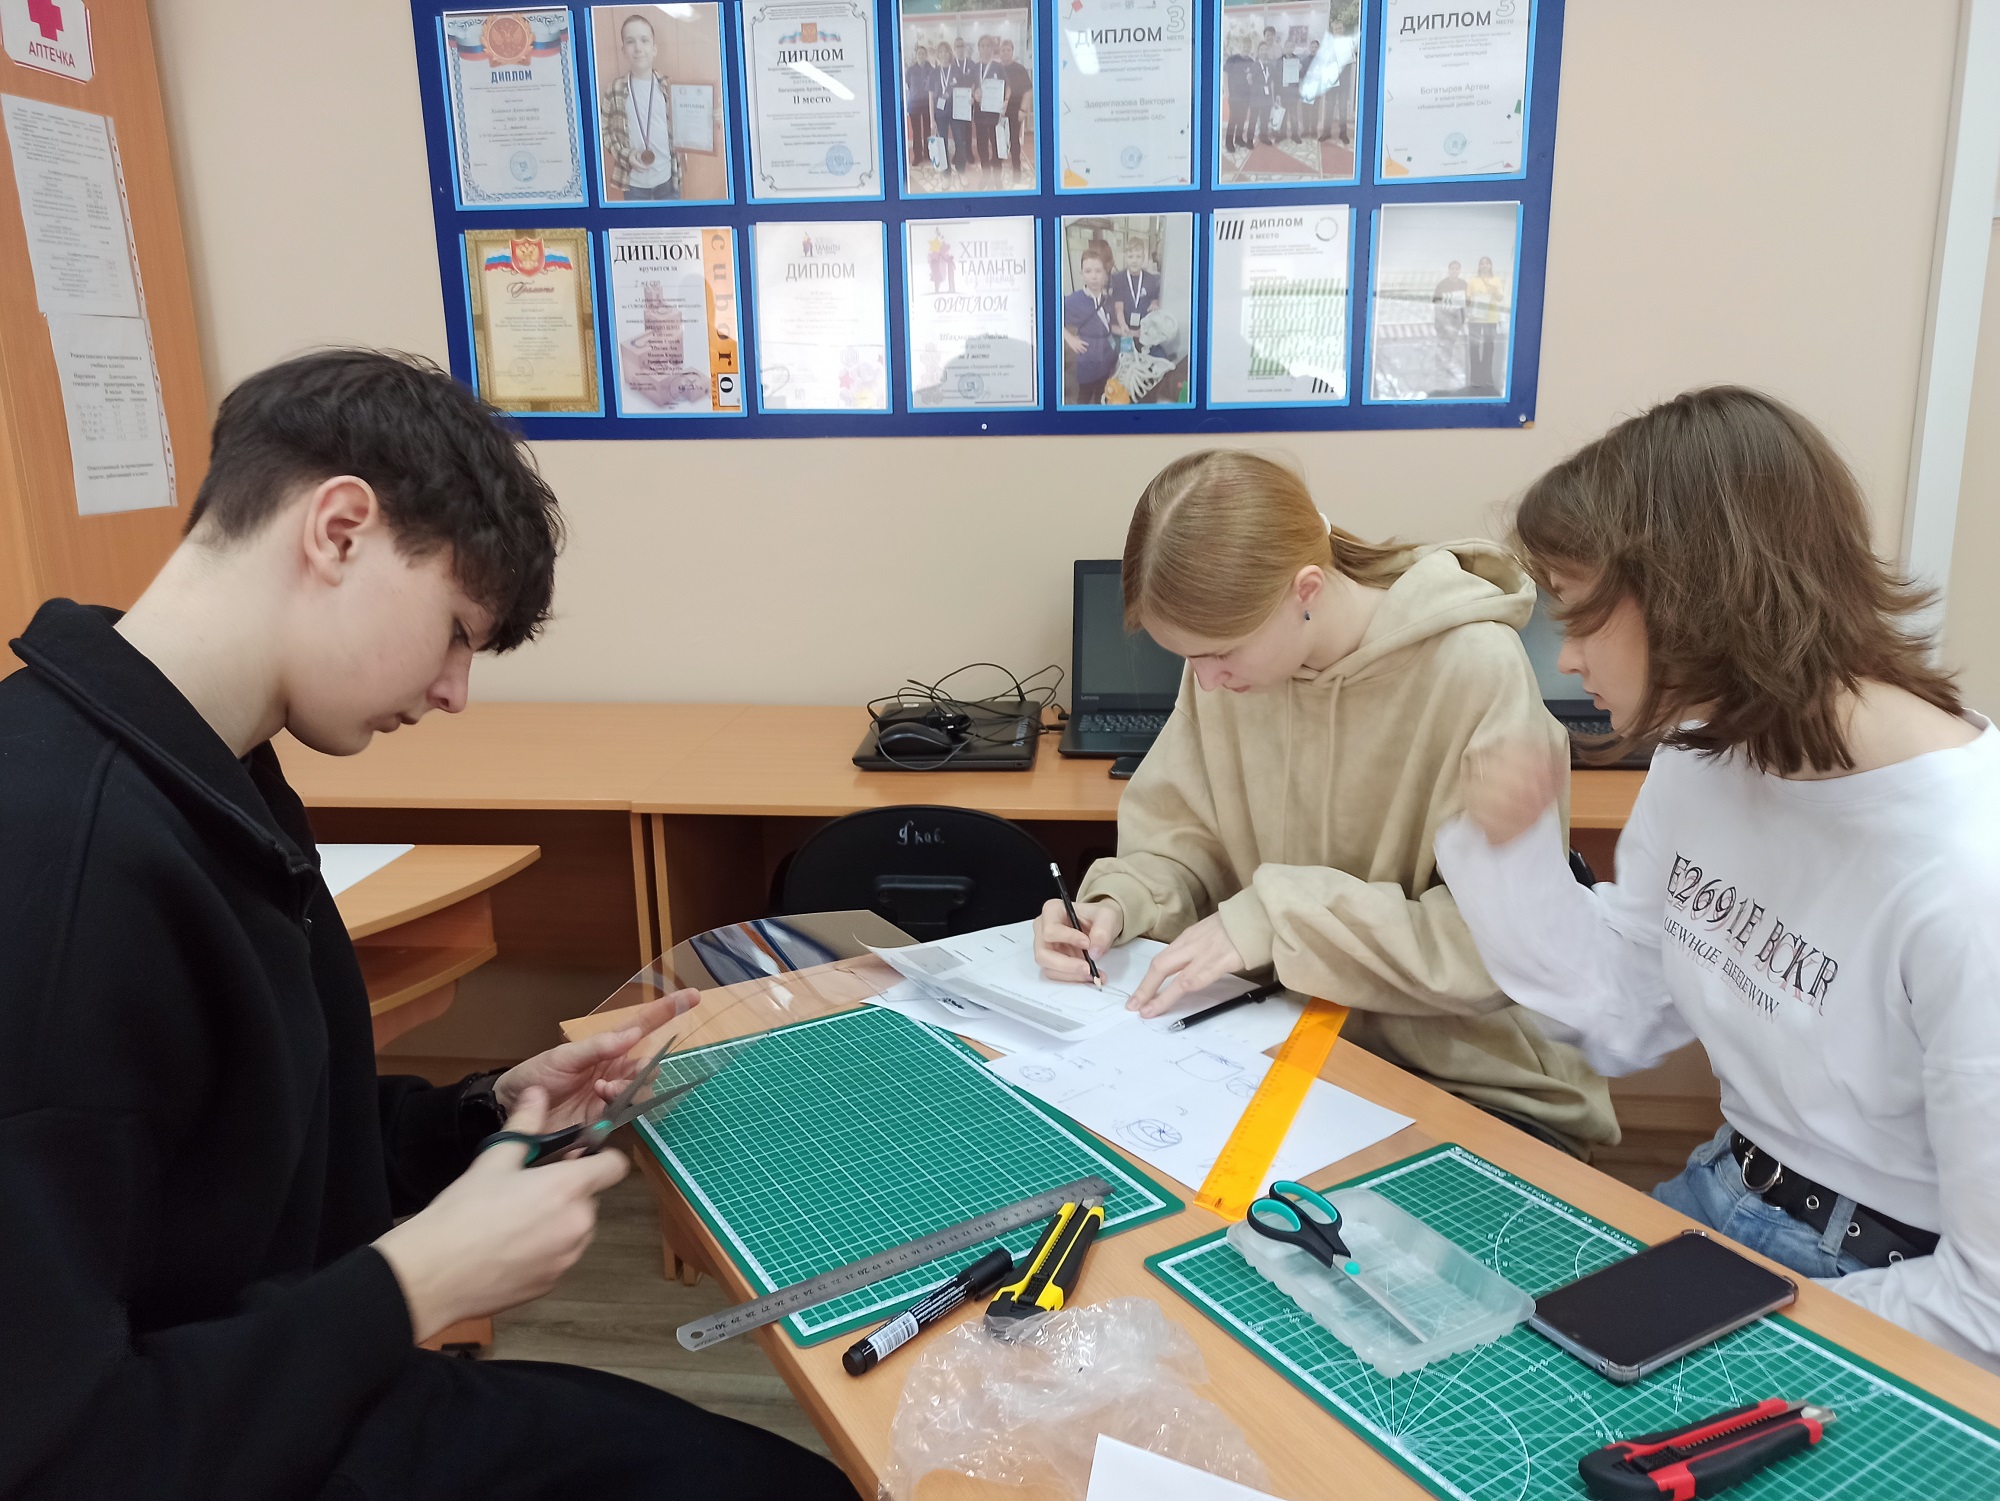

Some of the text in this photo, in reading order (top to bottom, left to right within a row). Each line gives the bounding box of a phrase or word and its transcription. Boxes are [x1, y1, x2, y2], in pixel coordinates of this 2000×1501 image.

[1166, 5, 1185, 33] 3
[1400, 11, 1491, 35] ДИПЛОМ
[1075, 26, 1162, 48] ДИПЛОМ
[29, 41, 76, 69] АПТЕЧКА
[777, 48, 844, 66] ДИПЛОМ
[491, 70, 532, 84] ДИПЛОМ
[1420, 83, 1490, 95] Богатырев Артем
[802, 96, 831, 104] место
[1139, 97, 1176, 107] Виктория
[1250, 217, 1303, 230] ДИПЛОМ
[614, 244, 700, 264] ДИПЛОМ
[959, 241, 988, 258] XIII
[786, 262, 855, 282] ДИПЛОМ
[959, 258, 1026, 276] ТАЛАНТЫ
[934, 295, 1008, 313] ДИПЛОМ
[1666, 851, 1839, 1008] E2691E BCKR
